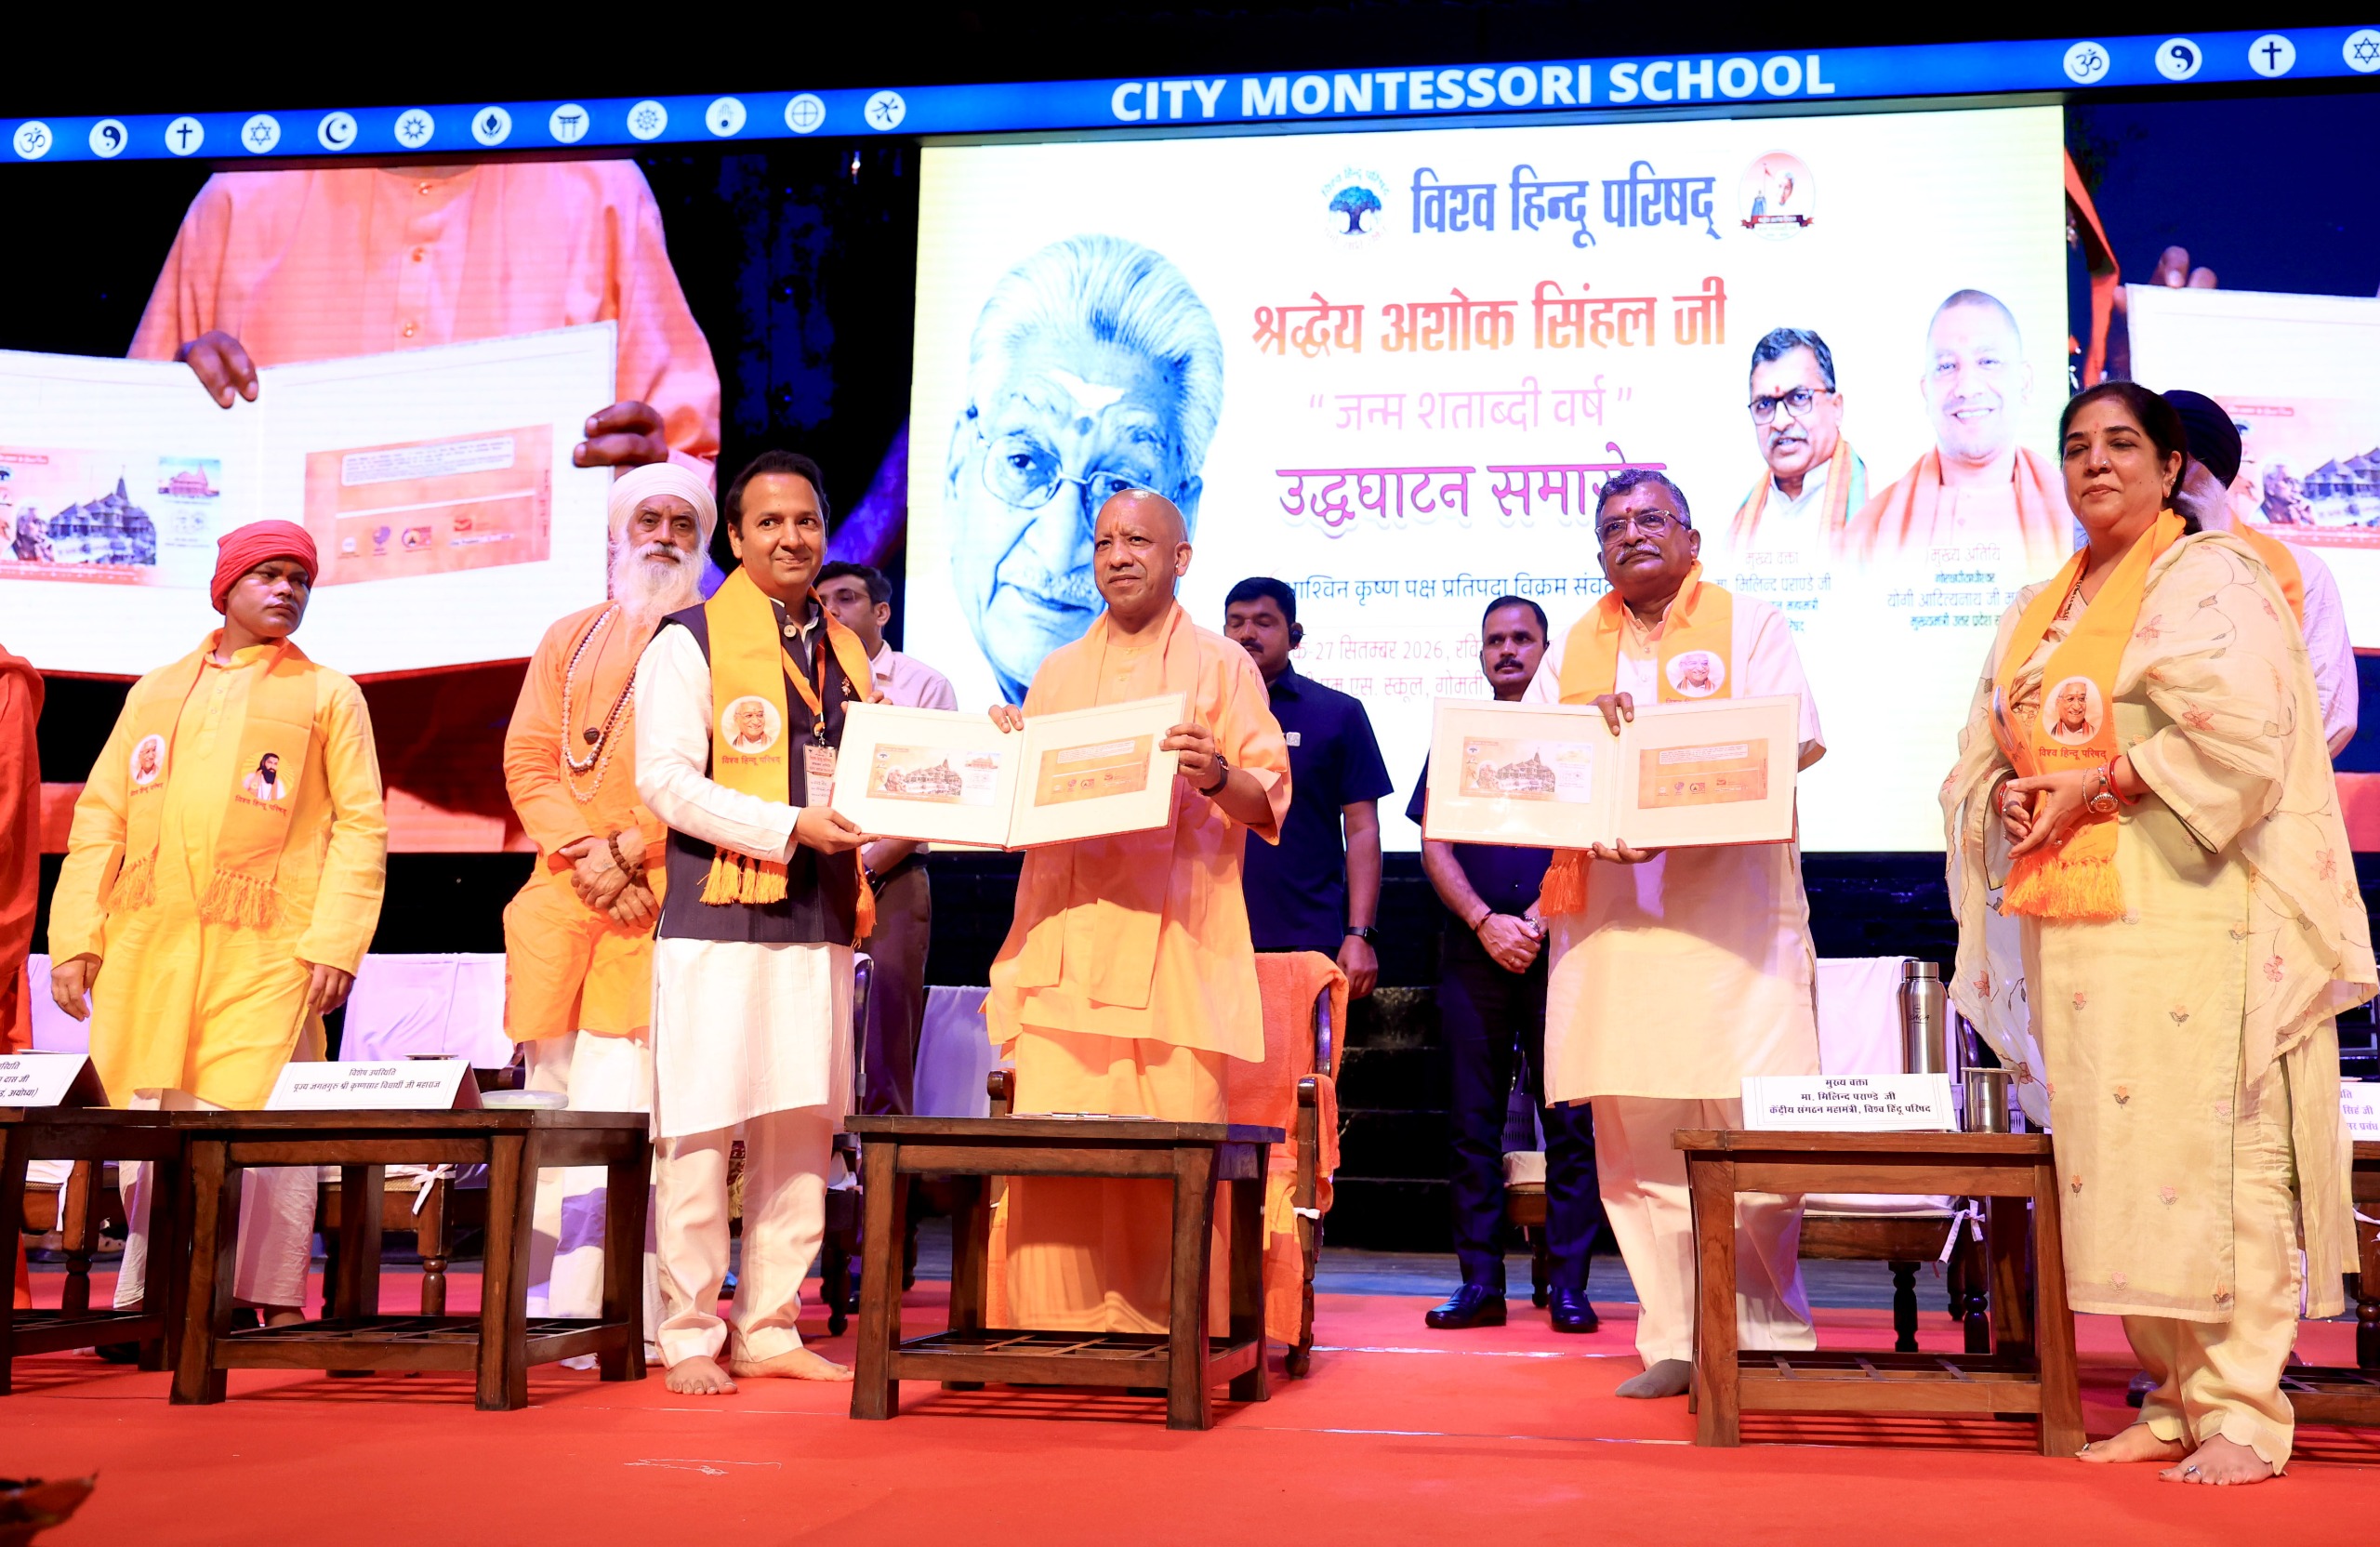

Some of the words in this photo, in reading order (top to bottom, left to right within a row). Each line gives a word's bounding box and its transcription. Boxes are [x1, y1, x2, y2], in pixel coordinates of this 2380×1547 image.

[1111, 79, 1227, 122] CITY
[1241, 64, 1592, 117] MONTESSORI
[1608, 54, 1835, 103] SCHOOL
[1411, 166, 1497, 233] विश्व
[1509, 164, 1596, 248] हिन्दू
[1602, 160, 1722, 240] परिषद्
[1251, 291, 1365, 358] श्रद्धेय
[1381, 287, 1518, 352] अशोक
[1531, 280, 1658, 350] सिंहल
[1672, 276, 1727, 346] जी
[1334, 393, 1407, 430] जन्म
[1418, 376, 1542, 431] शताब्दी
[1551, 374, 1606, 427] वर्ष
[1931, 549, 1960, 567] मुख्य
[1355, 580, 1399, 606] कृष्ण
[1405, 580, 1436, 599] पक्ष
[1442, 573, 1508, 598] प्रतिपदा
[1514, 572, 1567, 596] विक्रम
[1736, 573, 1777, 592] मिलिन्द
[1818, 572, 1831, 590] जी
[1887, 588, 1913, 607] योगी
[1919, 588, 1981, 607] आदित्यनाथ
[1987, 587, 2000, 606] जी
[1340, 635, 1397, 659] सितम्बर
[1435, 669, 1484, 695] गोमती
[721, 755, 739, 764] विश्व
[2039, 747, 2057, 757] विश्व
[2060, 747, 2081, 760] हिन्दू
[1825, 1078, 1846, 1089] मुख्य
[1818, 1091, 1850, 1101] मिलिन्द
[1884, 1091, 1896, 1101] जी
